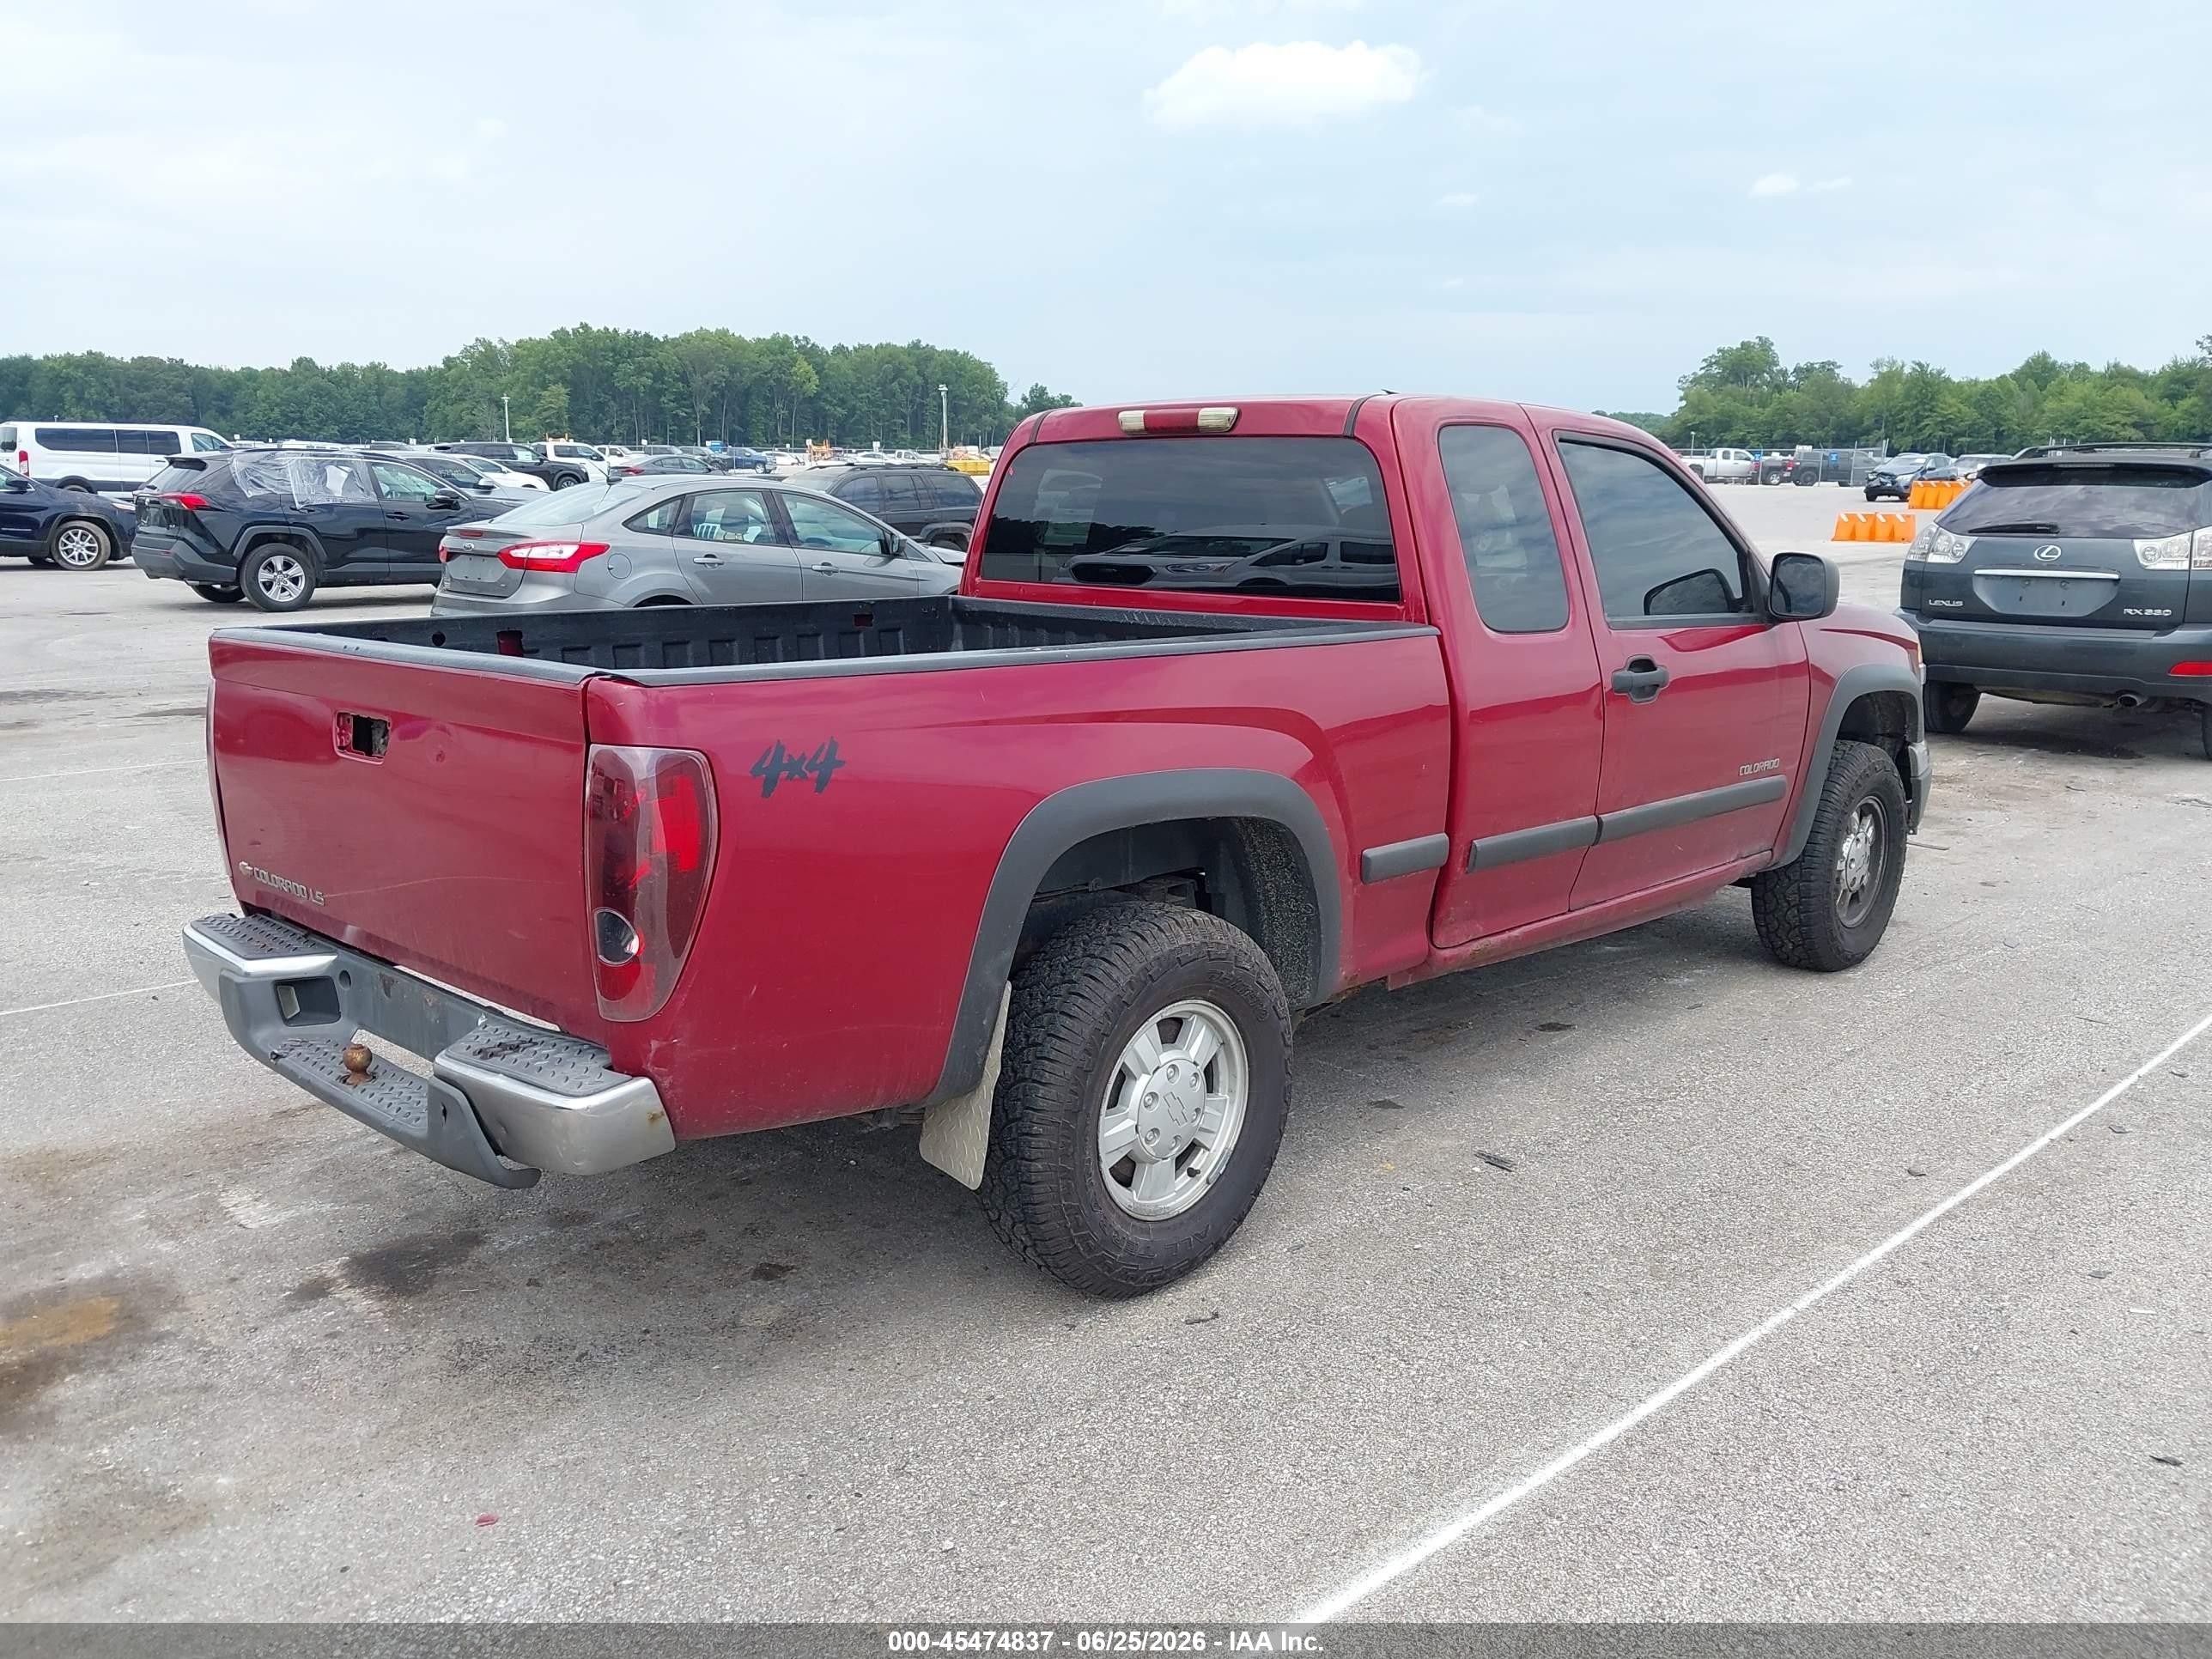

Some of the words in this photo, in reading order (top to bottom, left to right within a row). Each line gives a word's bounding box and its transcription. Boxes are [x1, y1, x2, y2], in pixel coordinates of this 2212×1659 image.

[1929, 599, 1964, 607] LEXUS
[2144, 608, 2172, 617] 330
[749, 736, 846, 799] 4x4
[1739, 757, 1780, 776] COLORADO
[253, 866, 308, 900] COLORADO
[309, 887, 325, 907] LS
